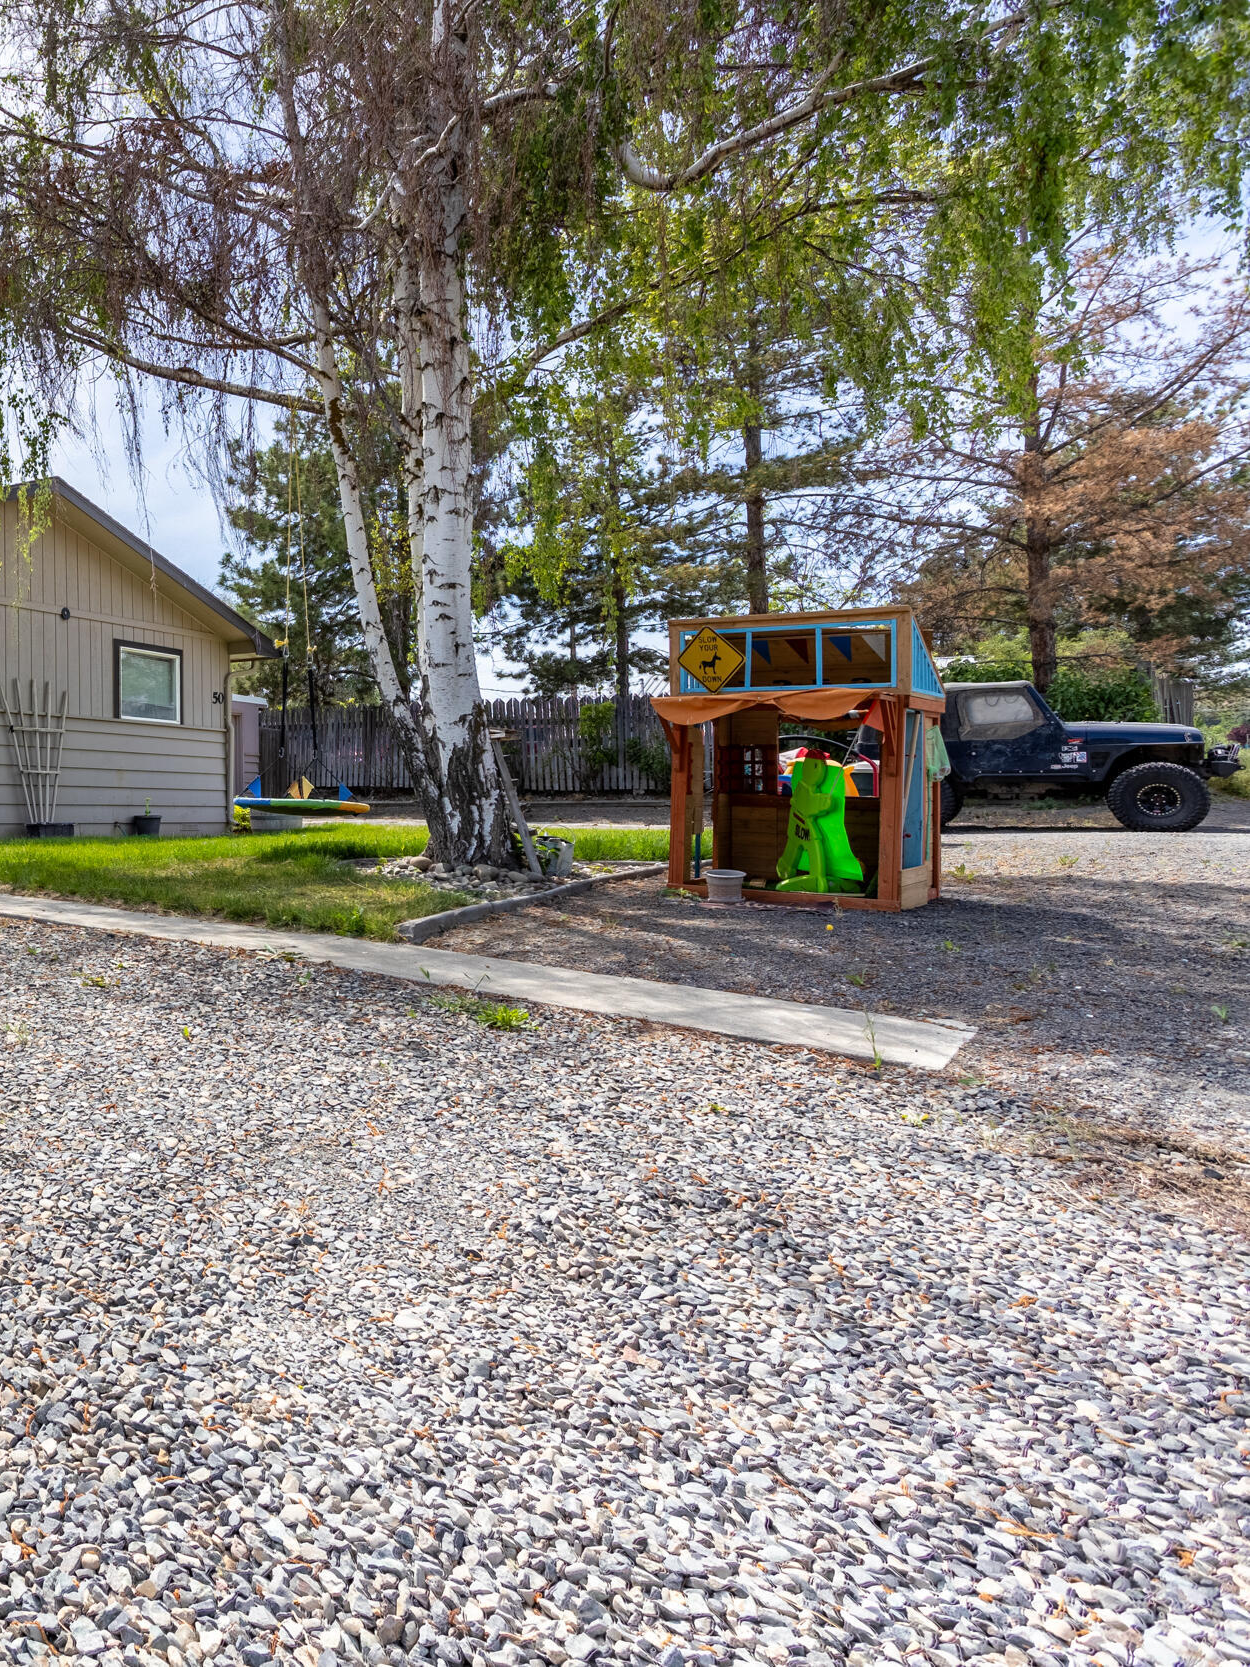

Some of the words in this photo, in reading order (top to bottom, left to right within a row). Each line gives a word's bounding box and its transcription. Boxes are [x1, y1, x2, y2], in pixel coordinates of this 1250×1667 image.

[698, 636, 717, 644] SLOW
[699, 644, 718, 652] YOUR
[702, 675, 722, 683] DOWN
